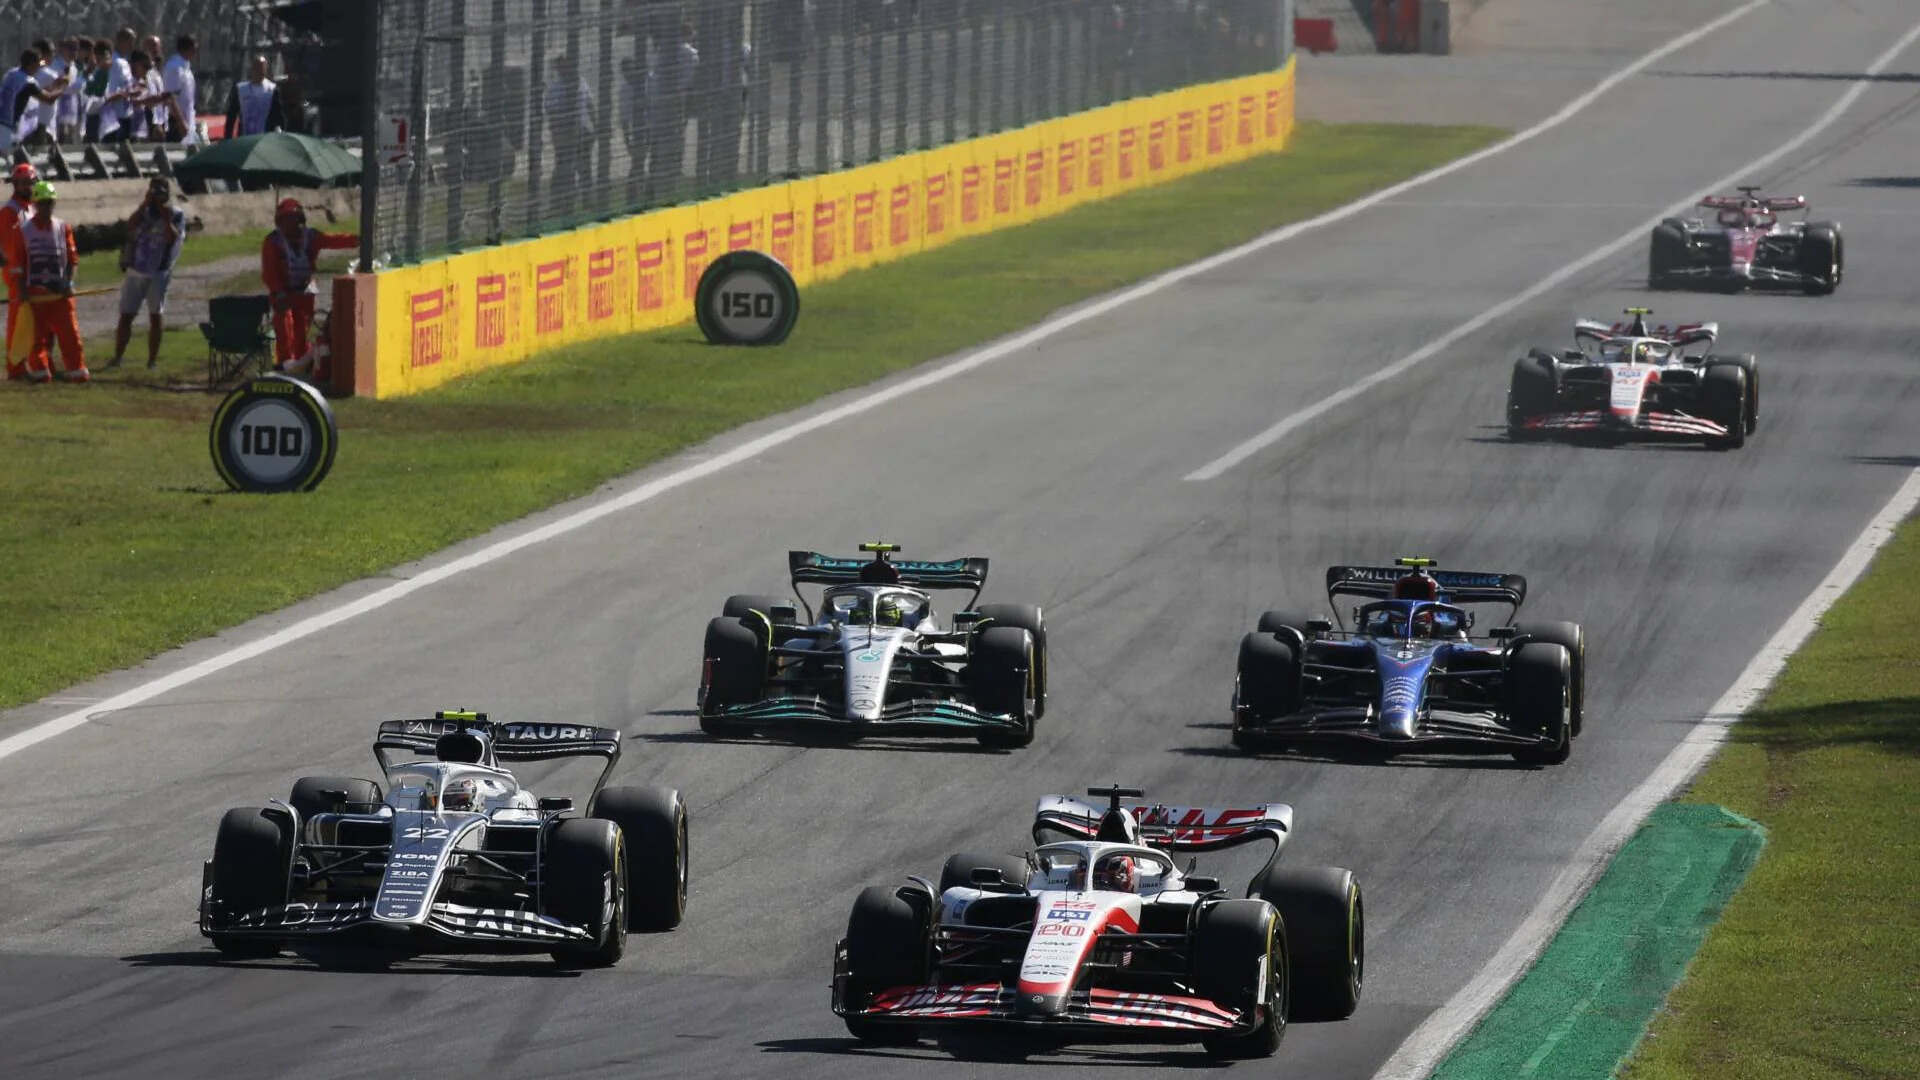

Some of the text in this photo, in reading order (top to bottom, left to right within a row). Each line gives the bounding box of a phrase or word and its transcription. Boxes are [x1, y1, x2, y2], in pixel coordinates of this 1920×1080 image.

[722, 292, 774, 318] 150
[241, 425, 302, 456] 100
[402, 827, 449, 839] 22
[1038, 924, 1086, 937] 20
